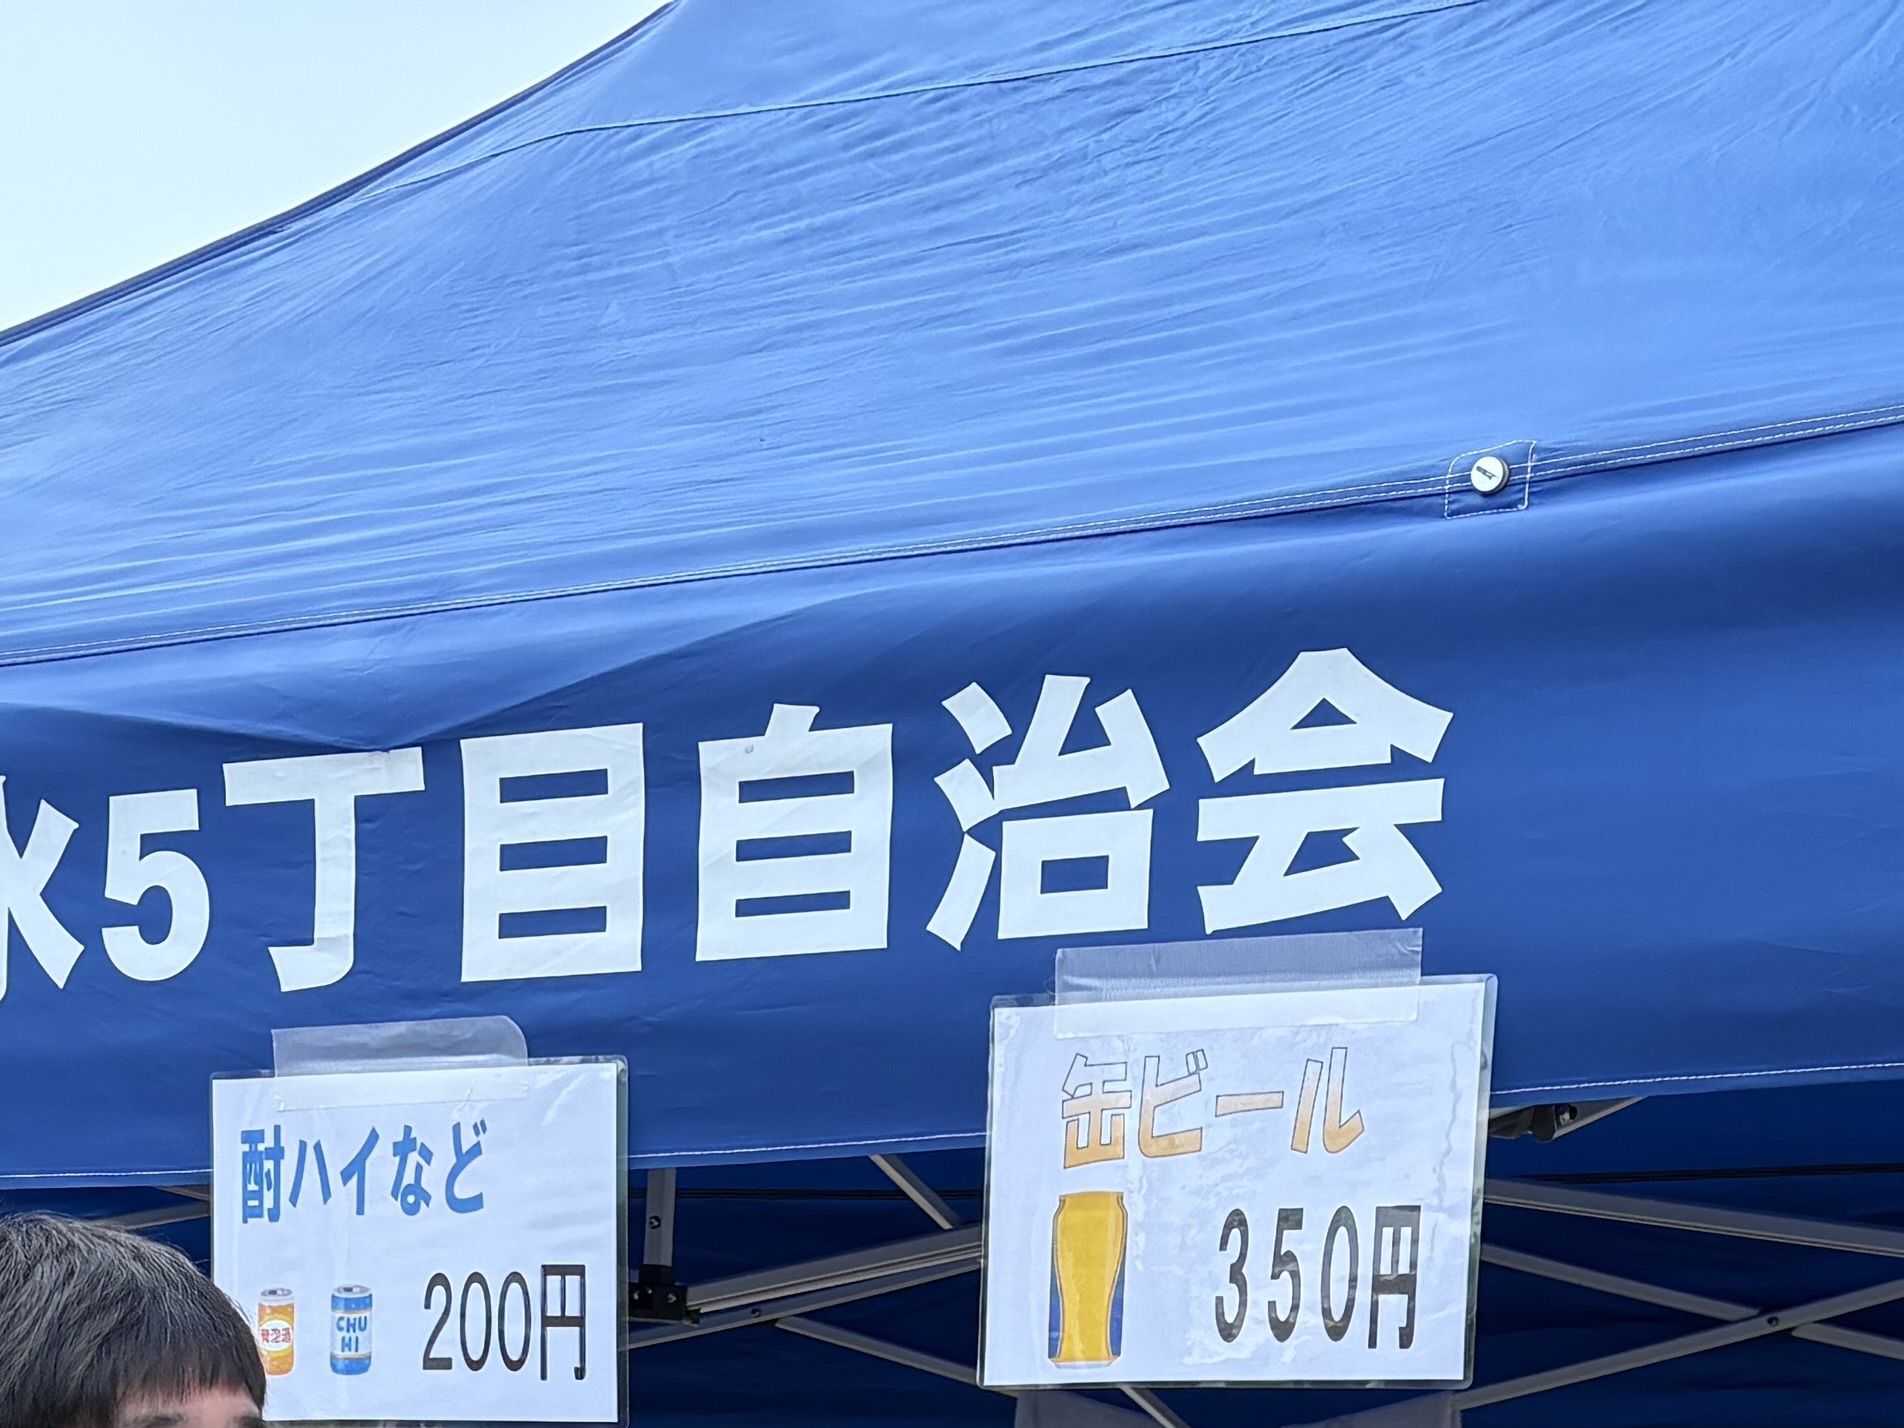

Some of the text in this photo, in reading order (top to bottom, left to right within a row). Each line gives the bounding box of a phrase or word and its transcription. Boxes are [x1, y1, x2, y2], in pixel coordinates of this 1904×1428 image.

[1062, 1046, 1365, 1169] 缶ビール
[241, 1118, 488, 1224] 酎ハイなど
[336, 1315, 367, 1334] CHU
[422, 1264, 586, 1381] 200円
[1215, 1204, 1421, 1351] 350円
[341, 1335, 359, 1353] HI
